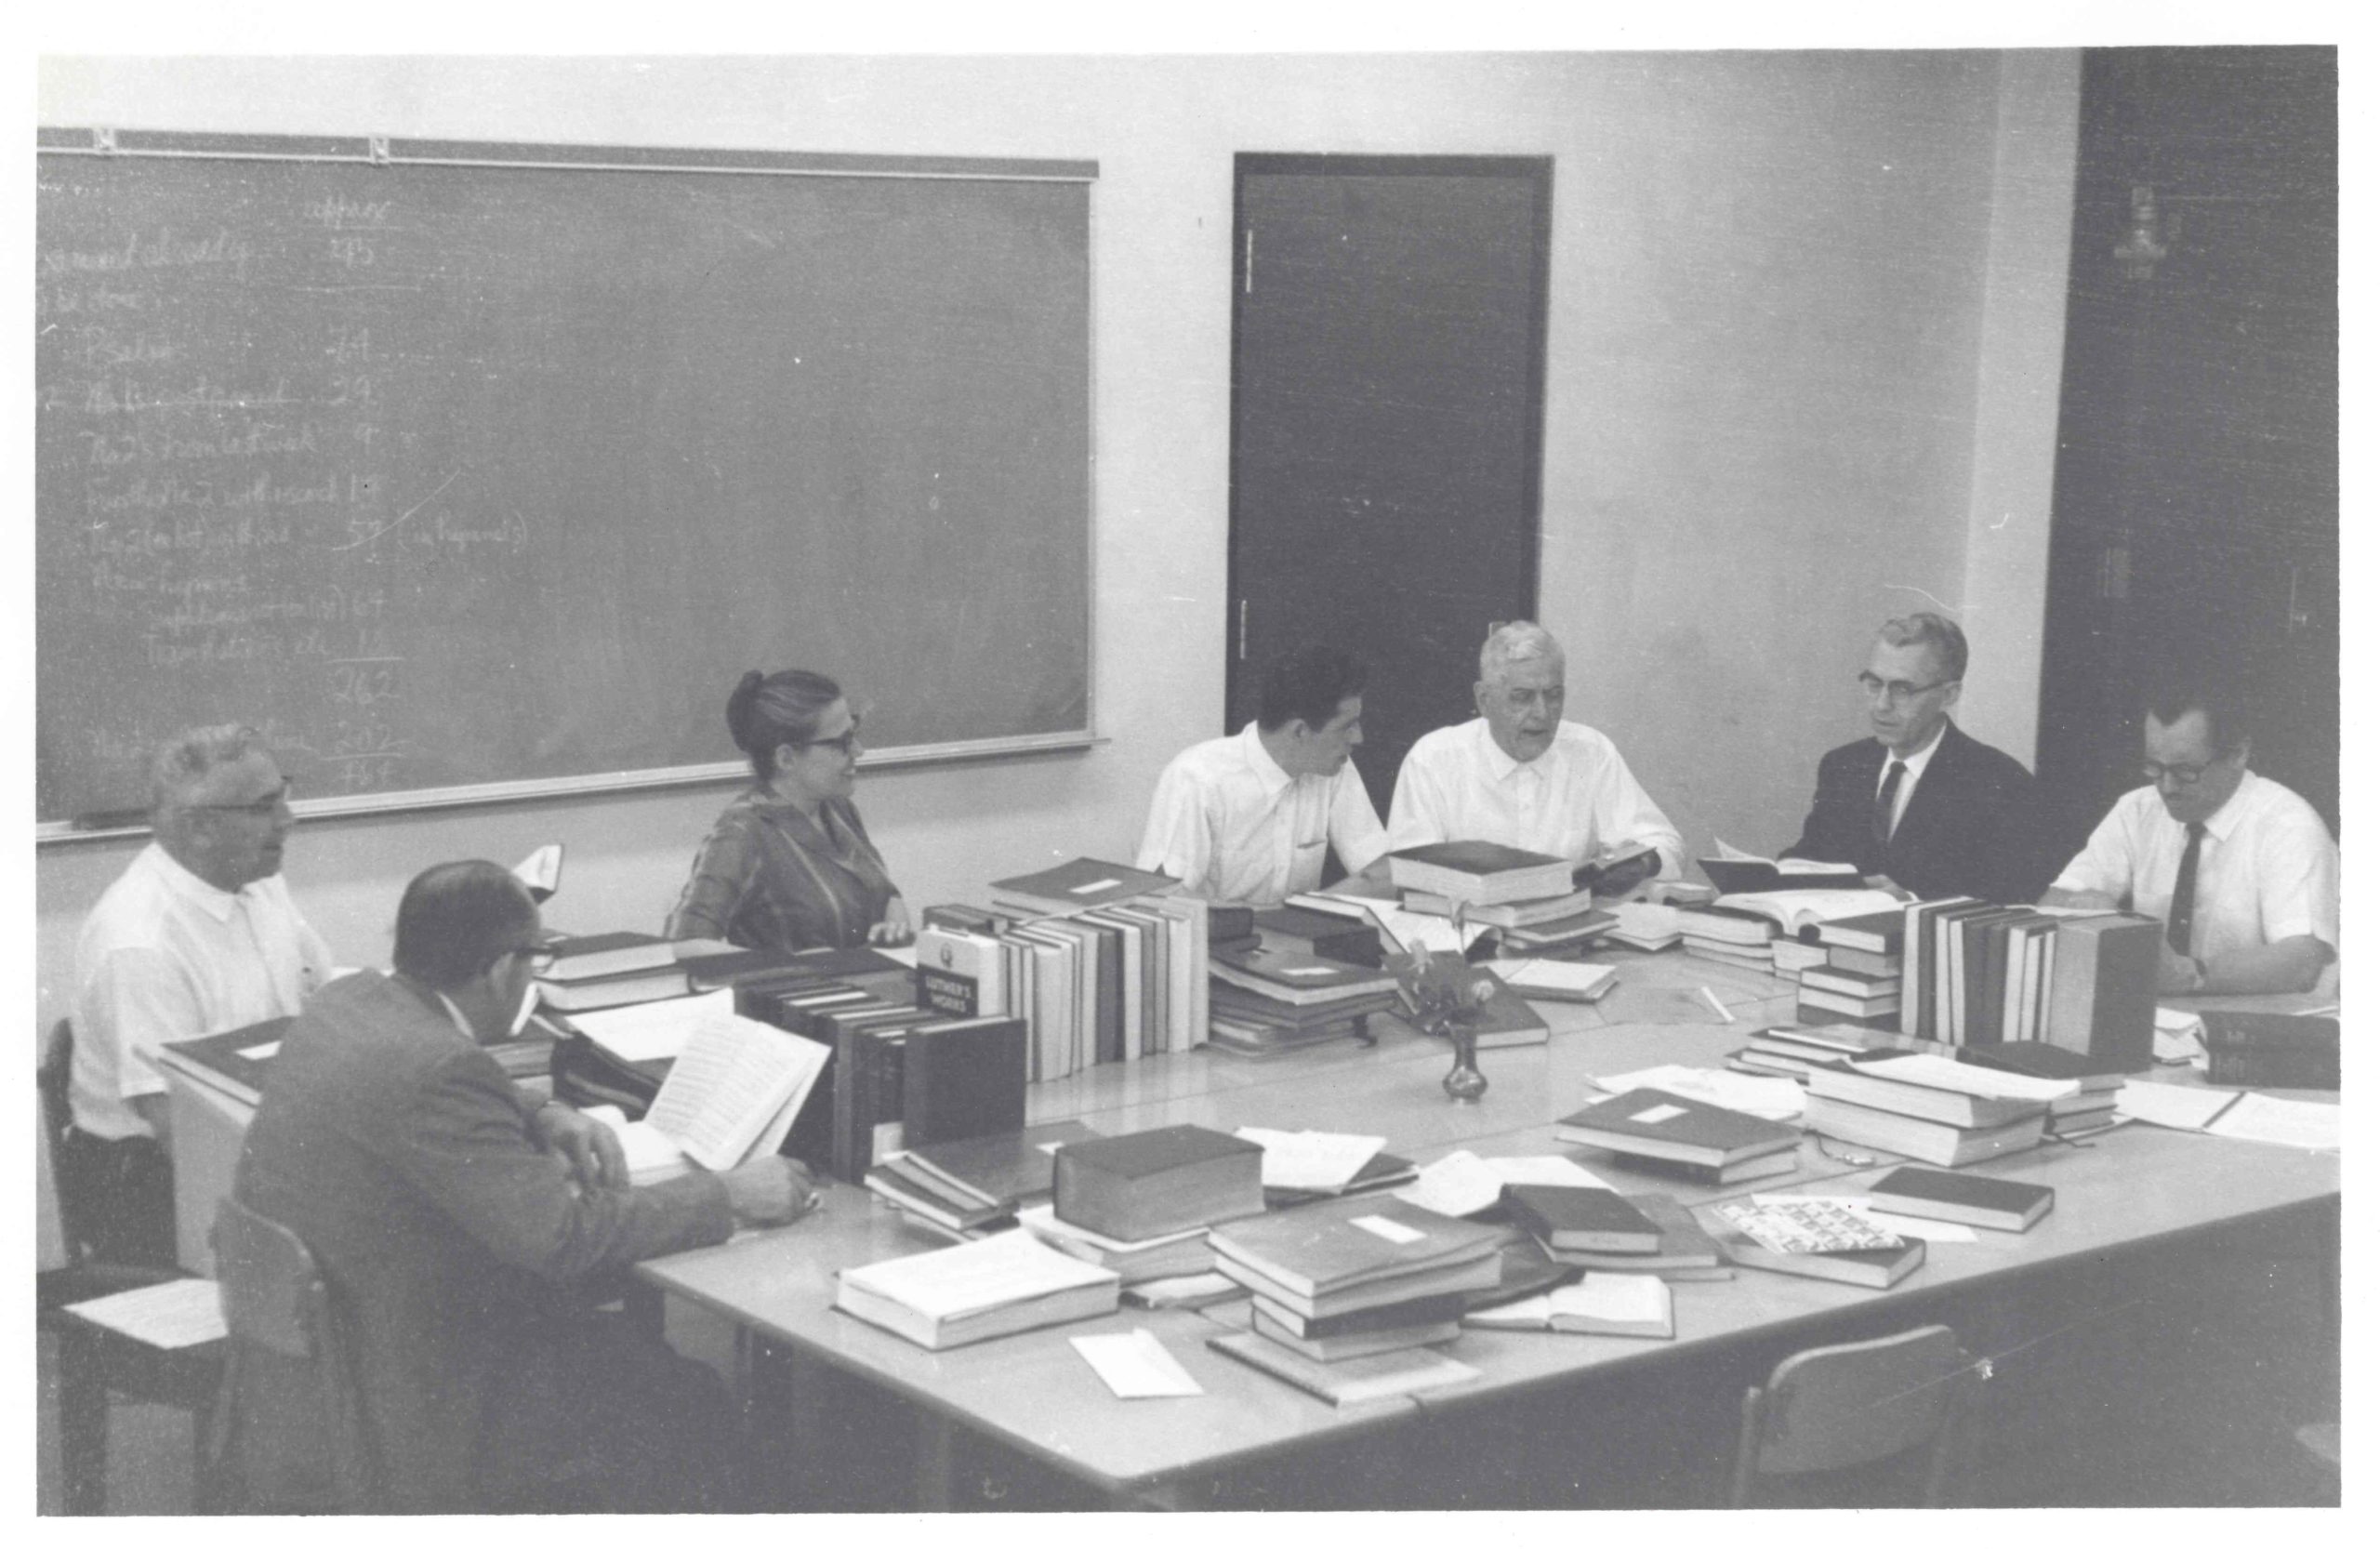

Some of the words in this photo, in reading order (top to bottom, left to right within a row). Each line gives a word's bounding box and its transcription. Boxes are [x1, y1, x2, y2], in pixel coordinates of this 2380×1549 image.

[334, 667, 401, 706] 262
[335, 719, 411, 755] 202
[925, 975, 972, 1000] LUTHER'S
[931, 993, 966, 1013] WORKS
